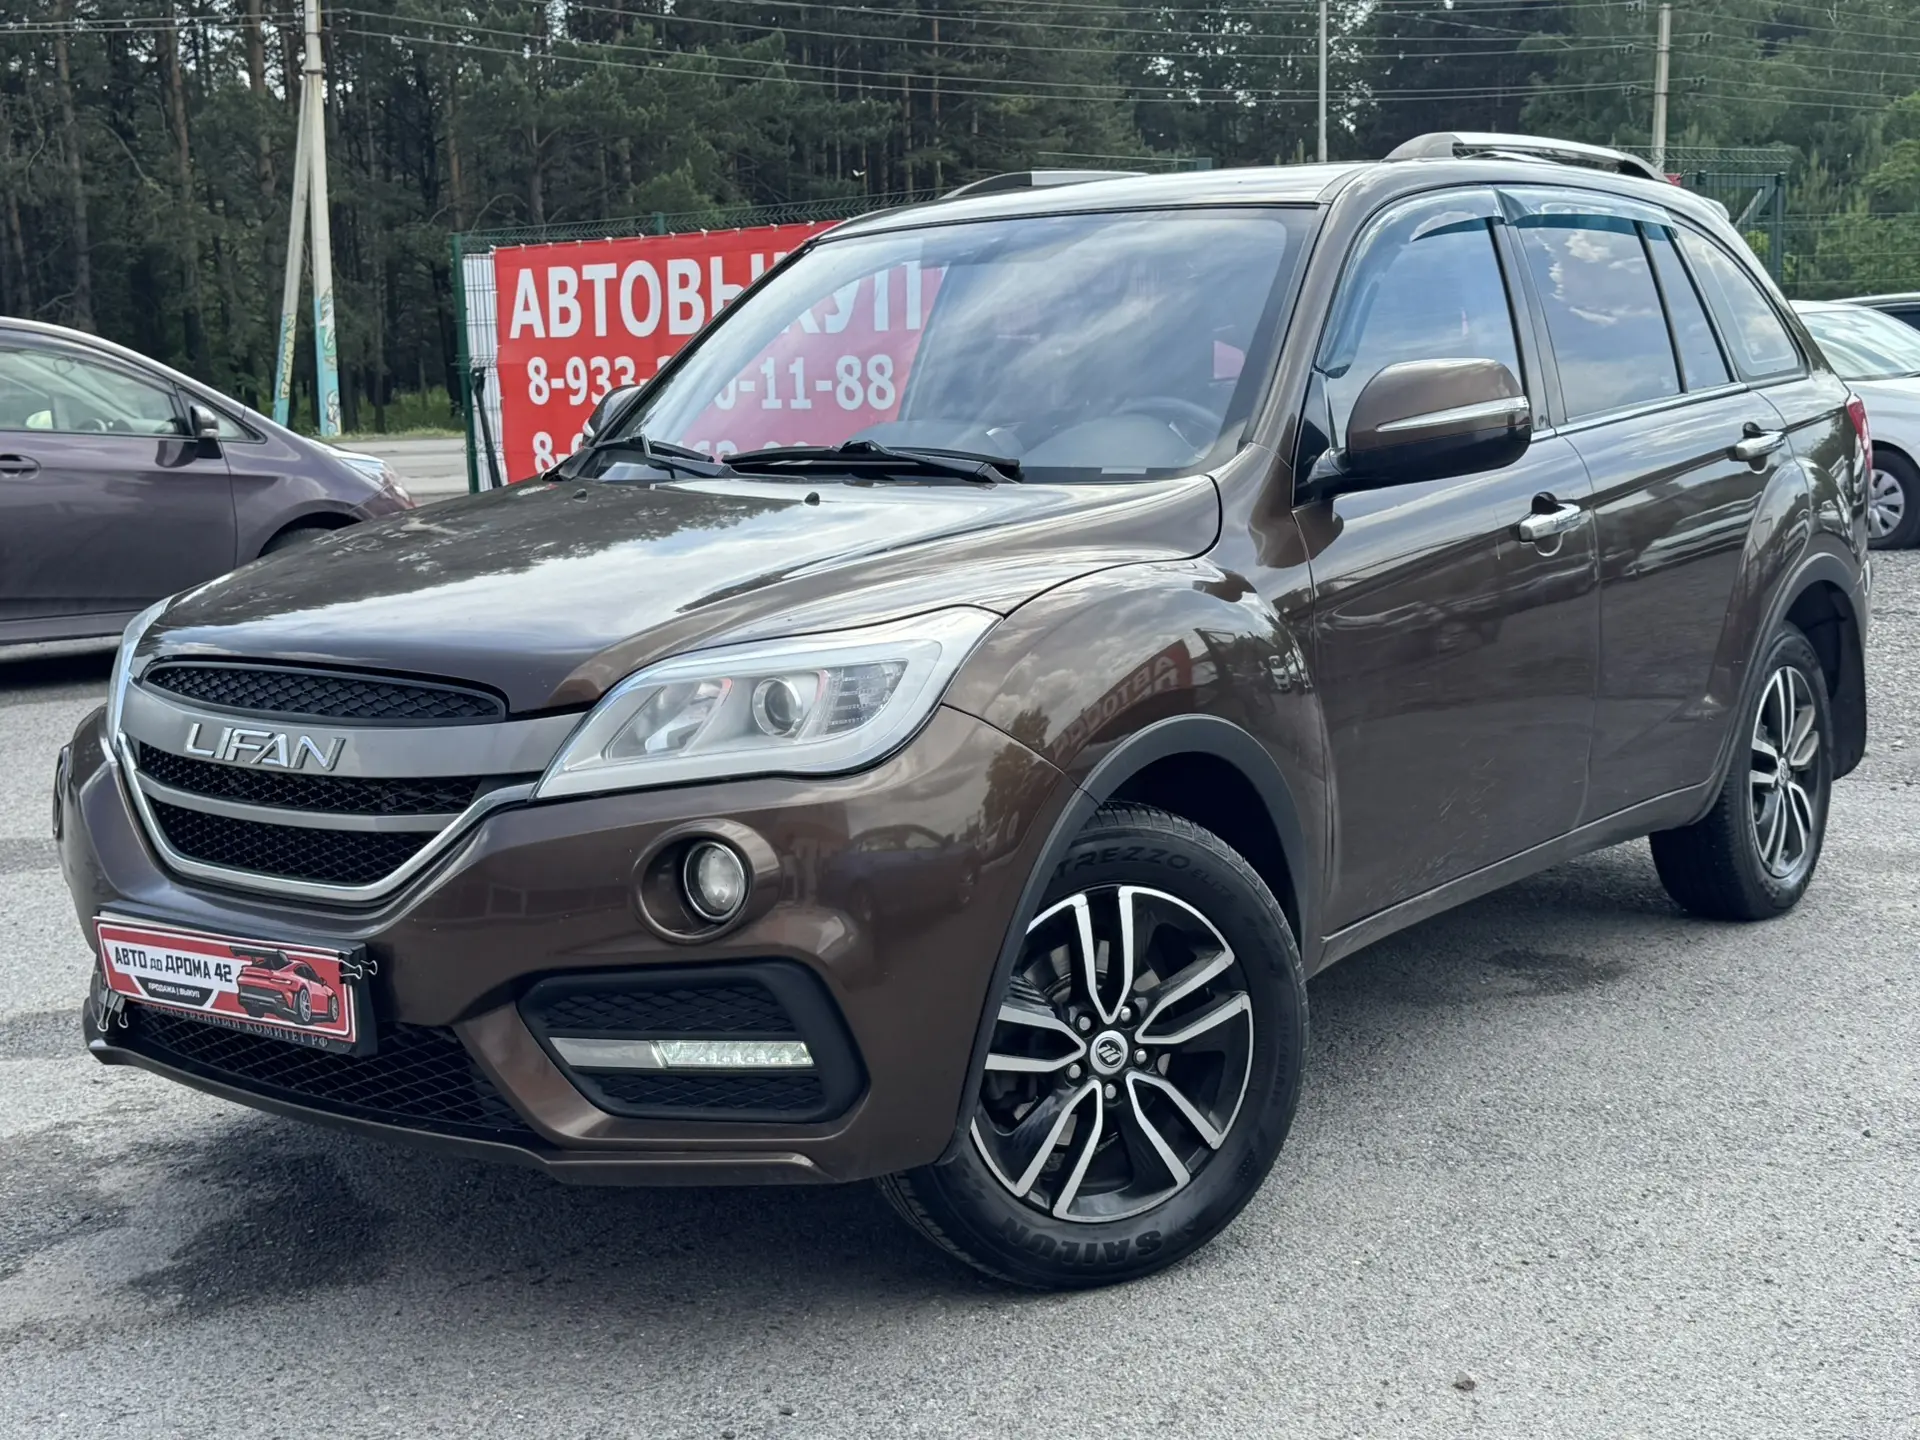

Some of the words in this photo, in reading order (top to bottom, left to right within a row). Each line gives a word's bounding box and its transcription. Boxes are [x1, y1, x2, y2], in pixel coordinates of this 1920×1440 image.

[184, 723, 347, 772] LIFAN
[115, 946, 148, 969] АВТО
[165, 955, 212, 980] ДРОМА
[214, 962, 233, 983] 42
[148, 982, 176, 995] ПРОДАЖА
[997, 1216, 1164, 1267] SAILUN
